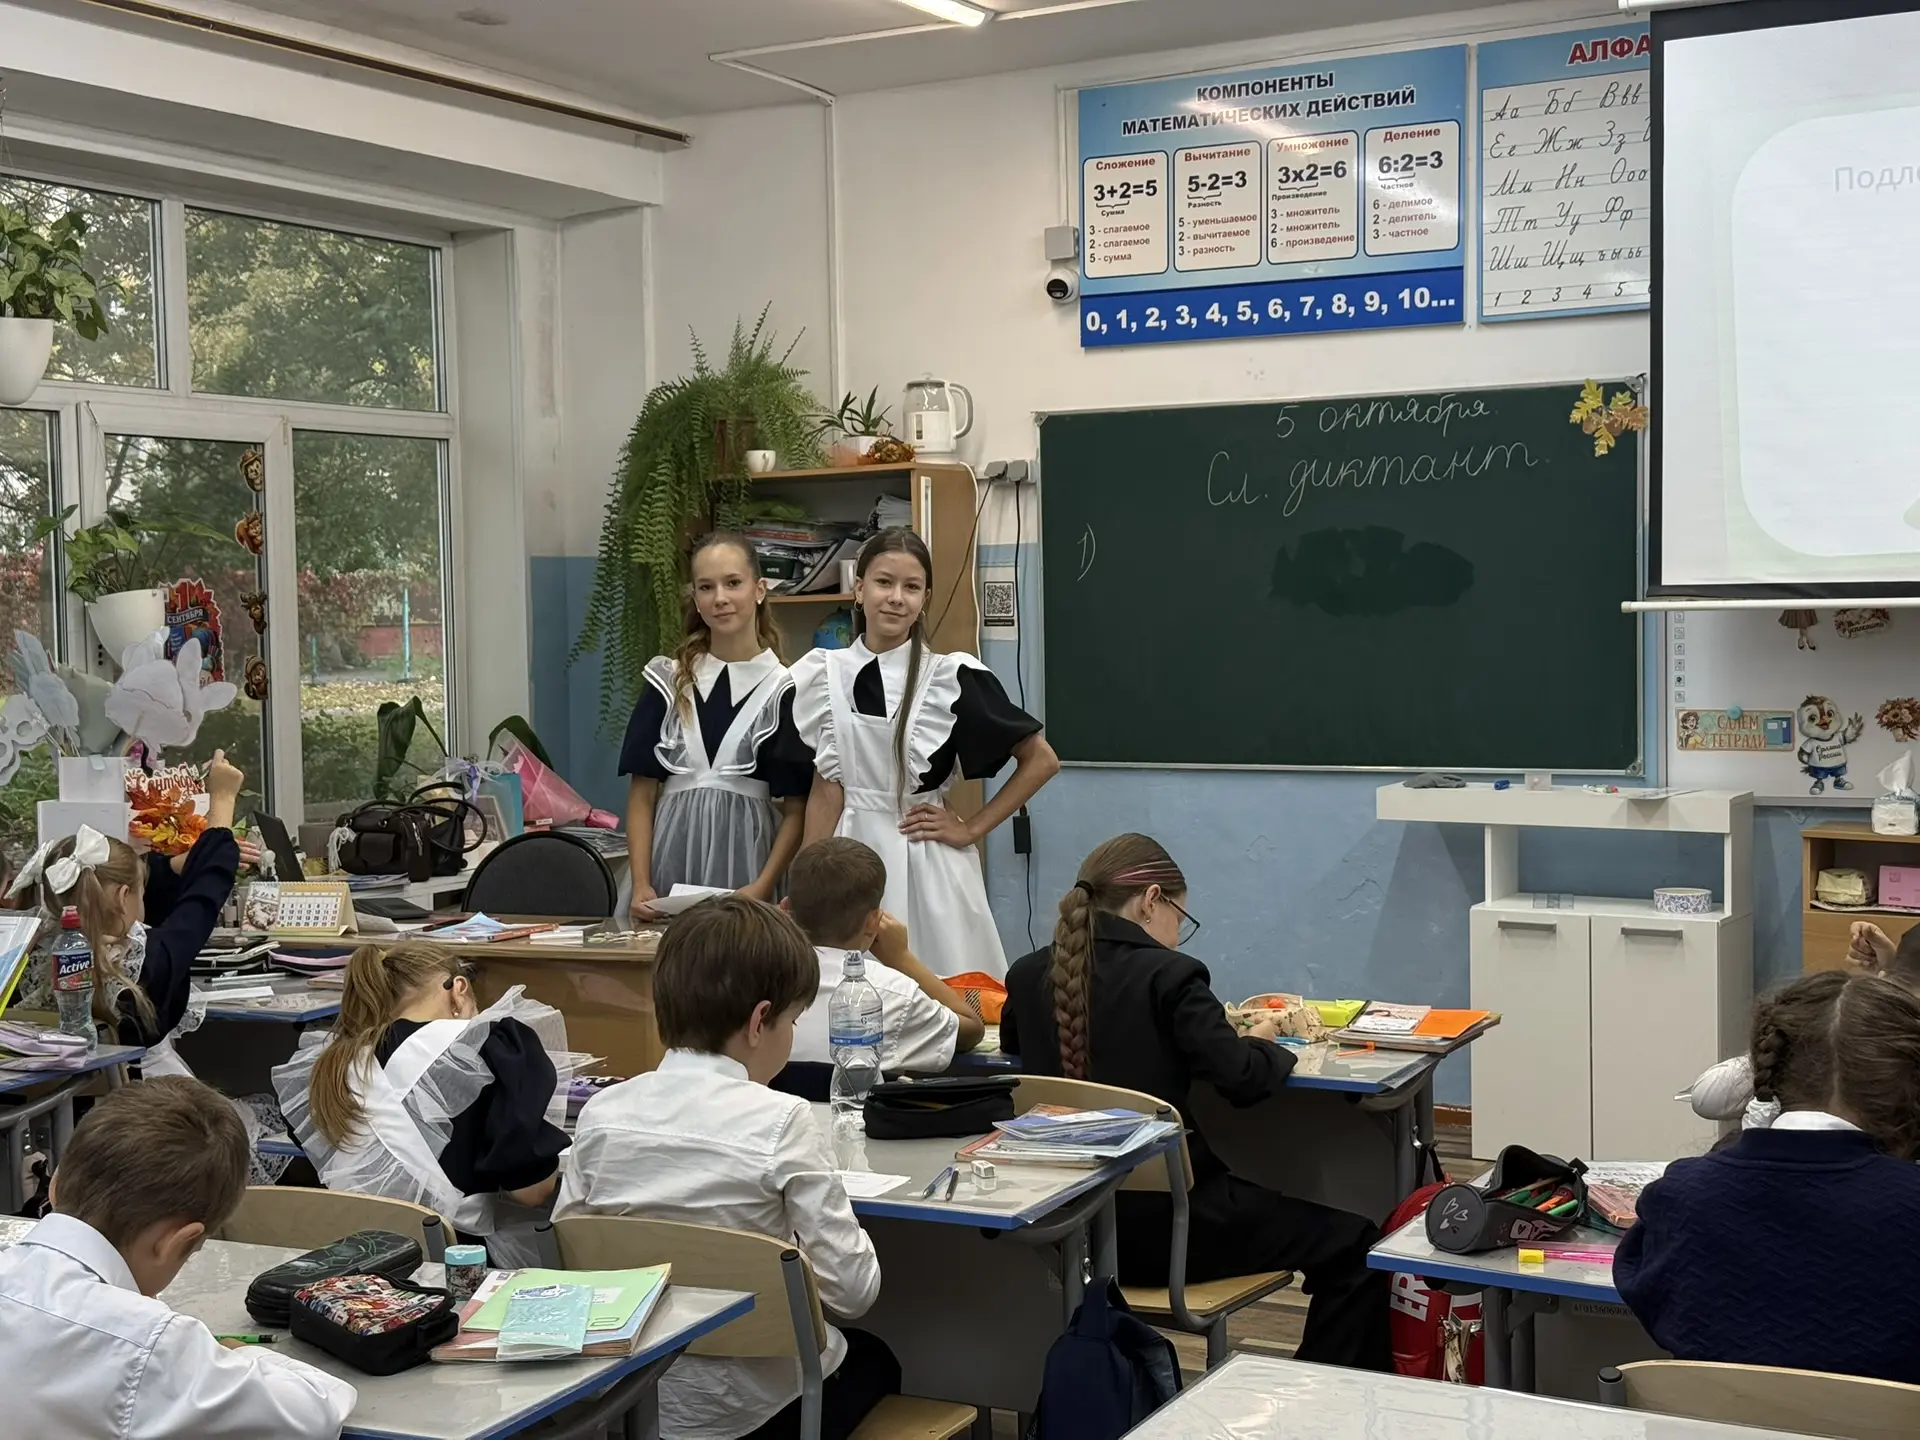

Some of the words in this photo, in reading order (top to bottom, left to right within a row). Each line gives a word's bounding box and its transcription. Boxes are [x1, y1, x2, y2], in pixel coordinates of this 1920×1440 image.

[1196, 72, 1335, 102] КОМПОНЕНТЫ
[1122, 103, 1301, 135] МАТЕМАТИЧЕСКИХ
[1306, 88, 1416, 117] ДЕЙСТВИЙ
[1383, 127, 1441, 143] Деление
[1276, 137, 1349, 152] Умножение
[1184, 148, 1251, 162] Вычитание
[1378, 150, 1443, 174] 6:2=3
[1095, 157, 1156, 171] Сложение
[1187, 170, 1247, 193] 5-2=3
[1380, 182, 1414, 190] Частное
[1834, 165, 1920, 196] Подл
[1093, 179, 1157, 201] 3+2=5
[1271, 190, 1327, 201] Произведение
[1187, 200, 1222, 209] Разность
[1373, 199, 1380, 210] 6
[1388, 198, 1433, 210] делимое
[1101, 209, 1125, 218] Сумма
[1271, 208, 1277, 219] 3
[1286, 206, 1341, 218] множитель
[1373, 214, 1380, 224] 2
[1388, 213, 1437, 225] делитель
[1178, 217, 1185, 227] 5
[1192, 213, 1257, 228] уменьшаемое
[1271, 223, 1277, 233] 2
[1286, 220, 1341, 232] множитель
[1089, 225, 1096, 235] 3
[1103, 223, 1150, 235] слагаемое
[1178, 231, 1185, 241] 2
[1192, 228, 1251, 241] вычитаемое
[1373, 229, 1380, 239] 3
[1388, 227, 1429, 238] частное
[1089, 239, 1096, 249] 2
[1103, 237, 1150, 249] слагаемое
[1271, 238, 1277, 248] 6
[1285, 234, 1355, 249] произведение
[1178, 246, 1185, 256] 3
[1192, 245, 1236, 257] разность
[1089, 253, 1096, 263] 5
[1103, 253, 1132, 264] сумма
[1494, 292, 1502, 307] 1
[1521, 289, 1532, 304] 2
[1552, 287, 1561, 302] 3
[1582, 284, 1592, 299] 4
[1614, 281, 1627, 296] 5
[1086, 311, 1108, 335] 0,
[1116, 309, 1137, 333] 1,
[1145, 307, 1167, 331] 2,
[1175, 304, 1197, 328] 3,
[1205, 302, 1228, 327] 4,
[1236, 300, 1259, 325] 5,
[1267, 298, 1290, 322] 6,
[1299, 295, 1323, 320] 7,
[1331, 293, 1355, 317] 8,
[1364, 290, 1388, 315] 9,
[1398, 287, 1455, 309] 10...
[1276, 405, 1300, 438] 5
[166, 607, 204, 624] СЕНТЯБРЯ
[1711, 733, 1767, 749] ТЕТРАДИ
[59, 960, 90, 975] Active
